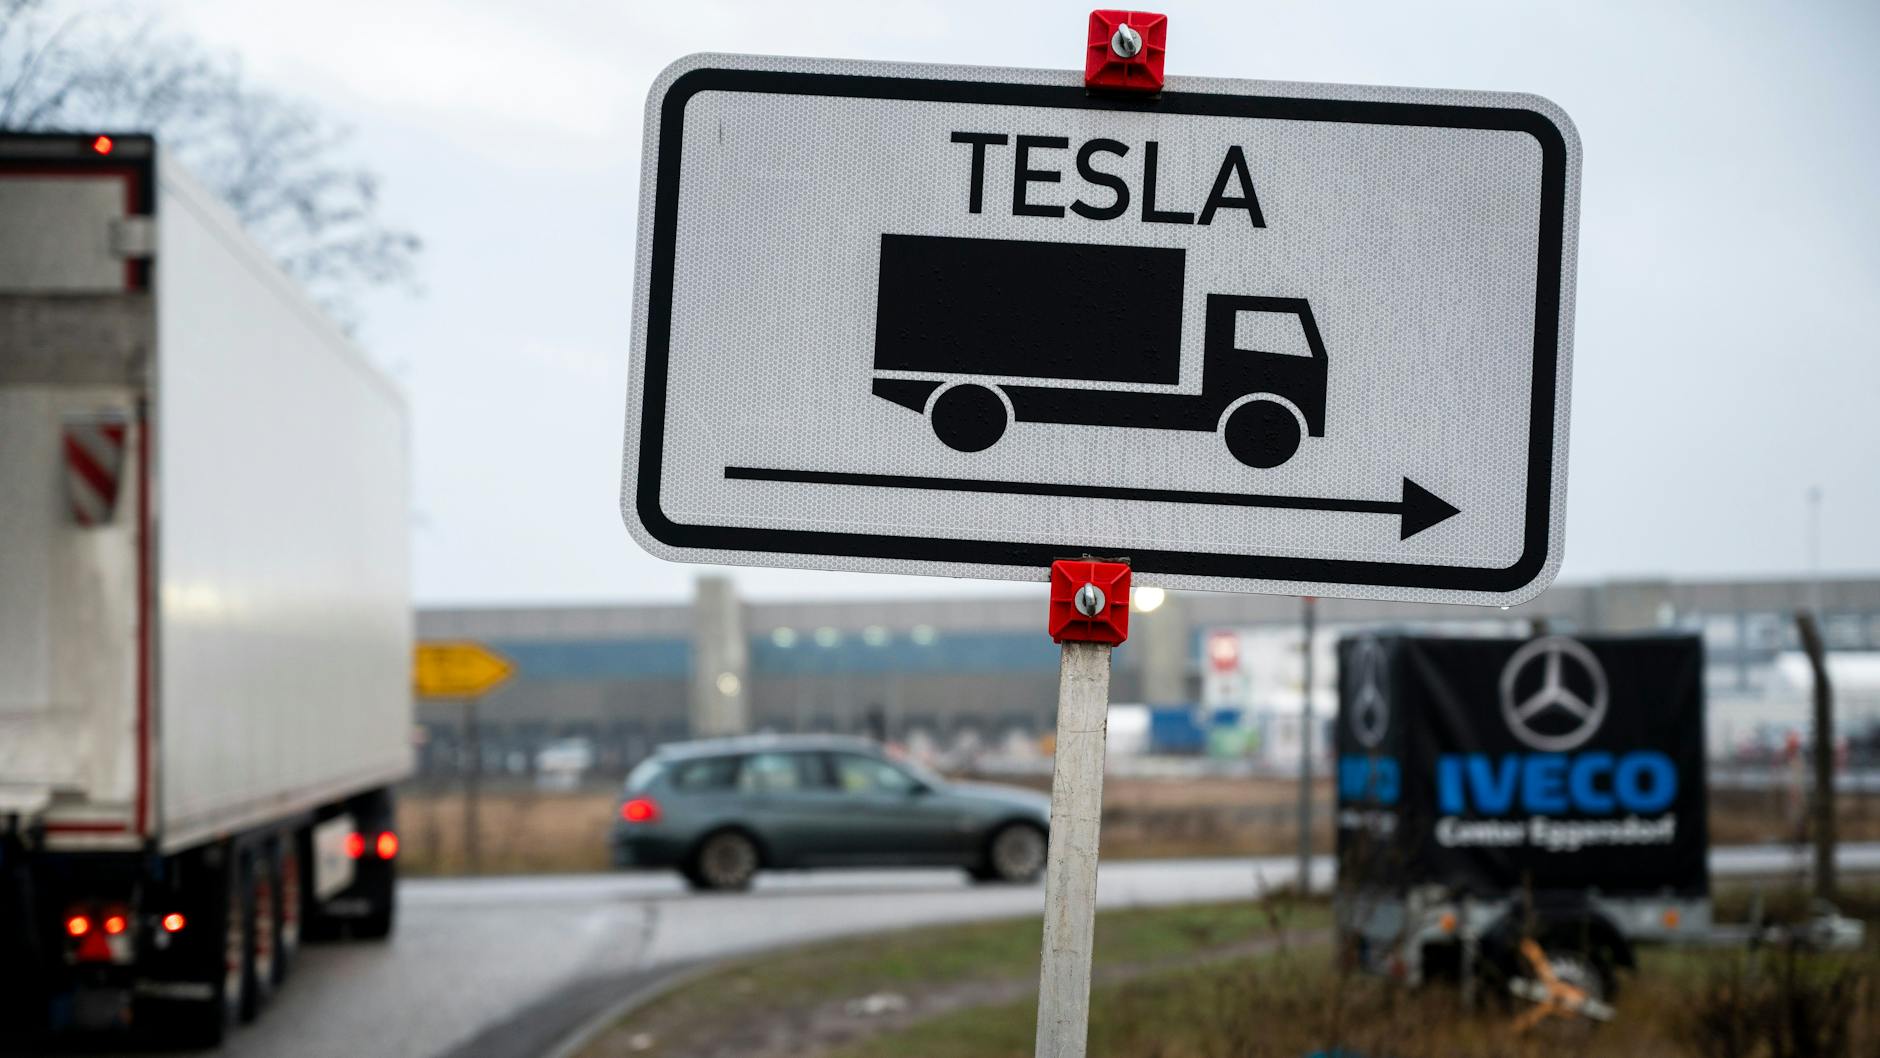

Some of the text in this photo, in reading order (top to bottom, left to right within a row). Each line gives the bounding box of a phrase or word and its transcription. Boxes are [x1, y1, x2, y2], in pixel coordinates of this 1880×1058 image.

[951, 131, 1267, 229] TESLA
[1438, 752, 1677, 815] IVECO
[1436, 816, 1676, 850] Center Eggersdorf
